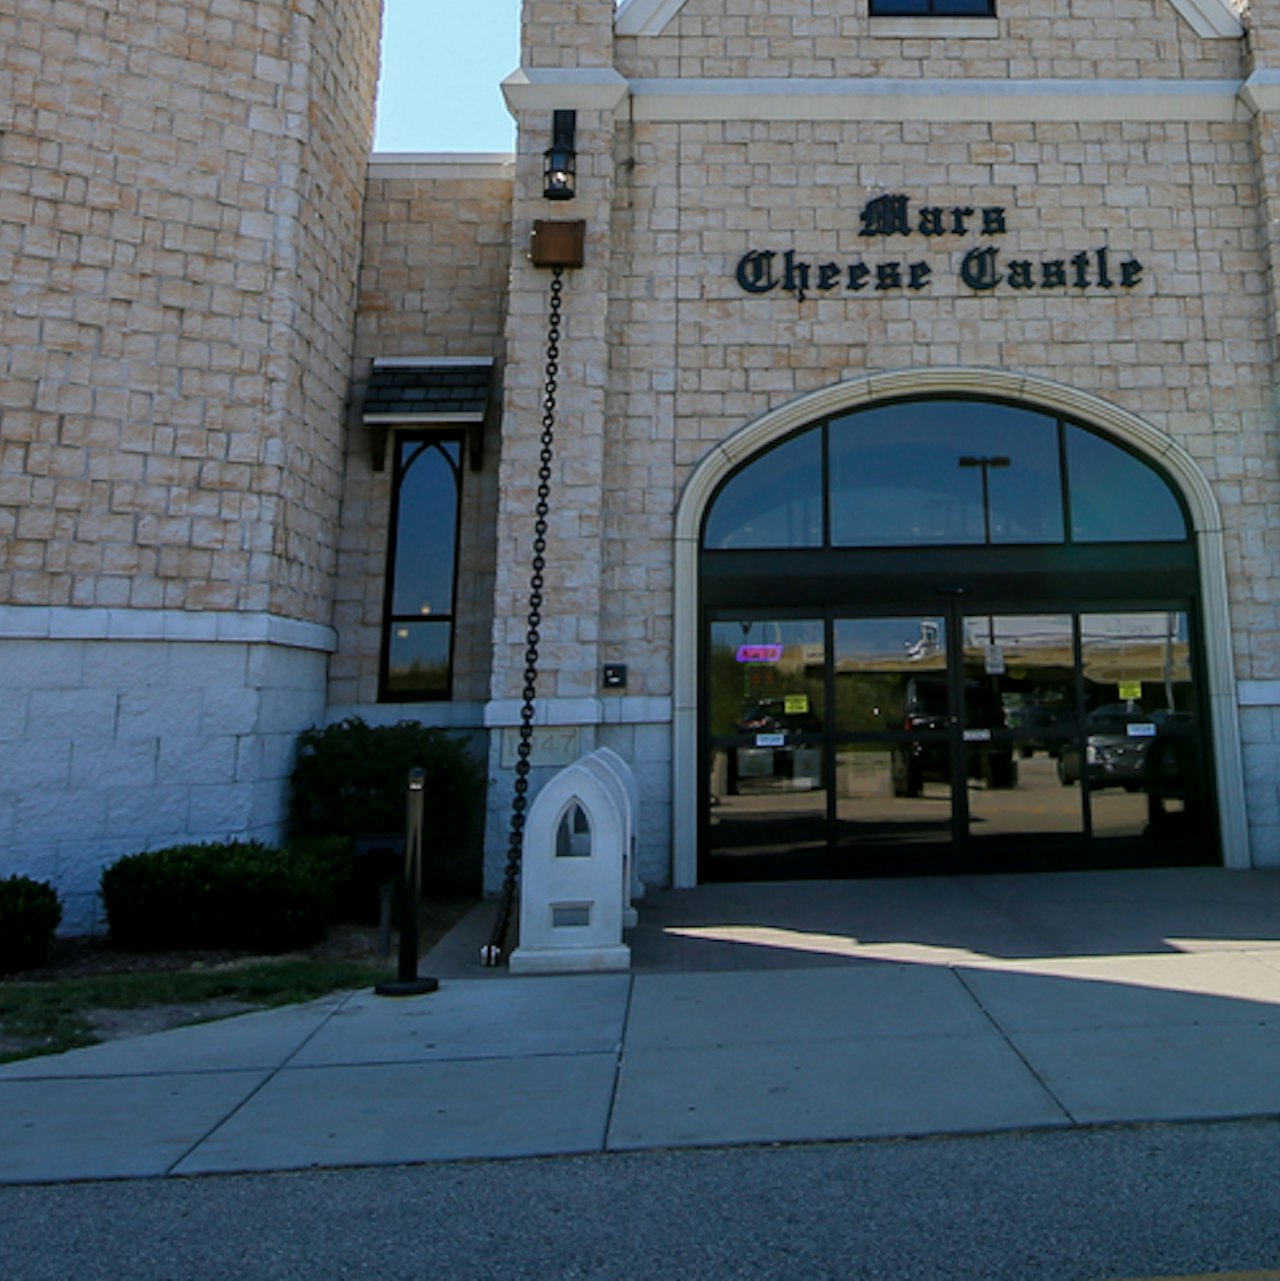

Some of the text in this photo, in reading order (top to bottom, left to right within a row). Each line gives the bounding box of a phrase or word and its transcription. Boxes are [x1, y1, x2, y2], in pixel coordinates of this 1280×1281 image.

[858, 194, 1007, 237] Mars
[736, 246, 1144, 303] Cheese Castle
